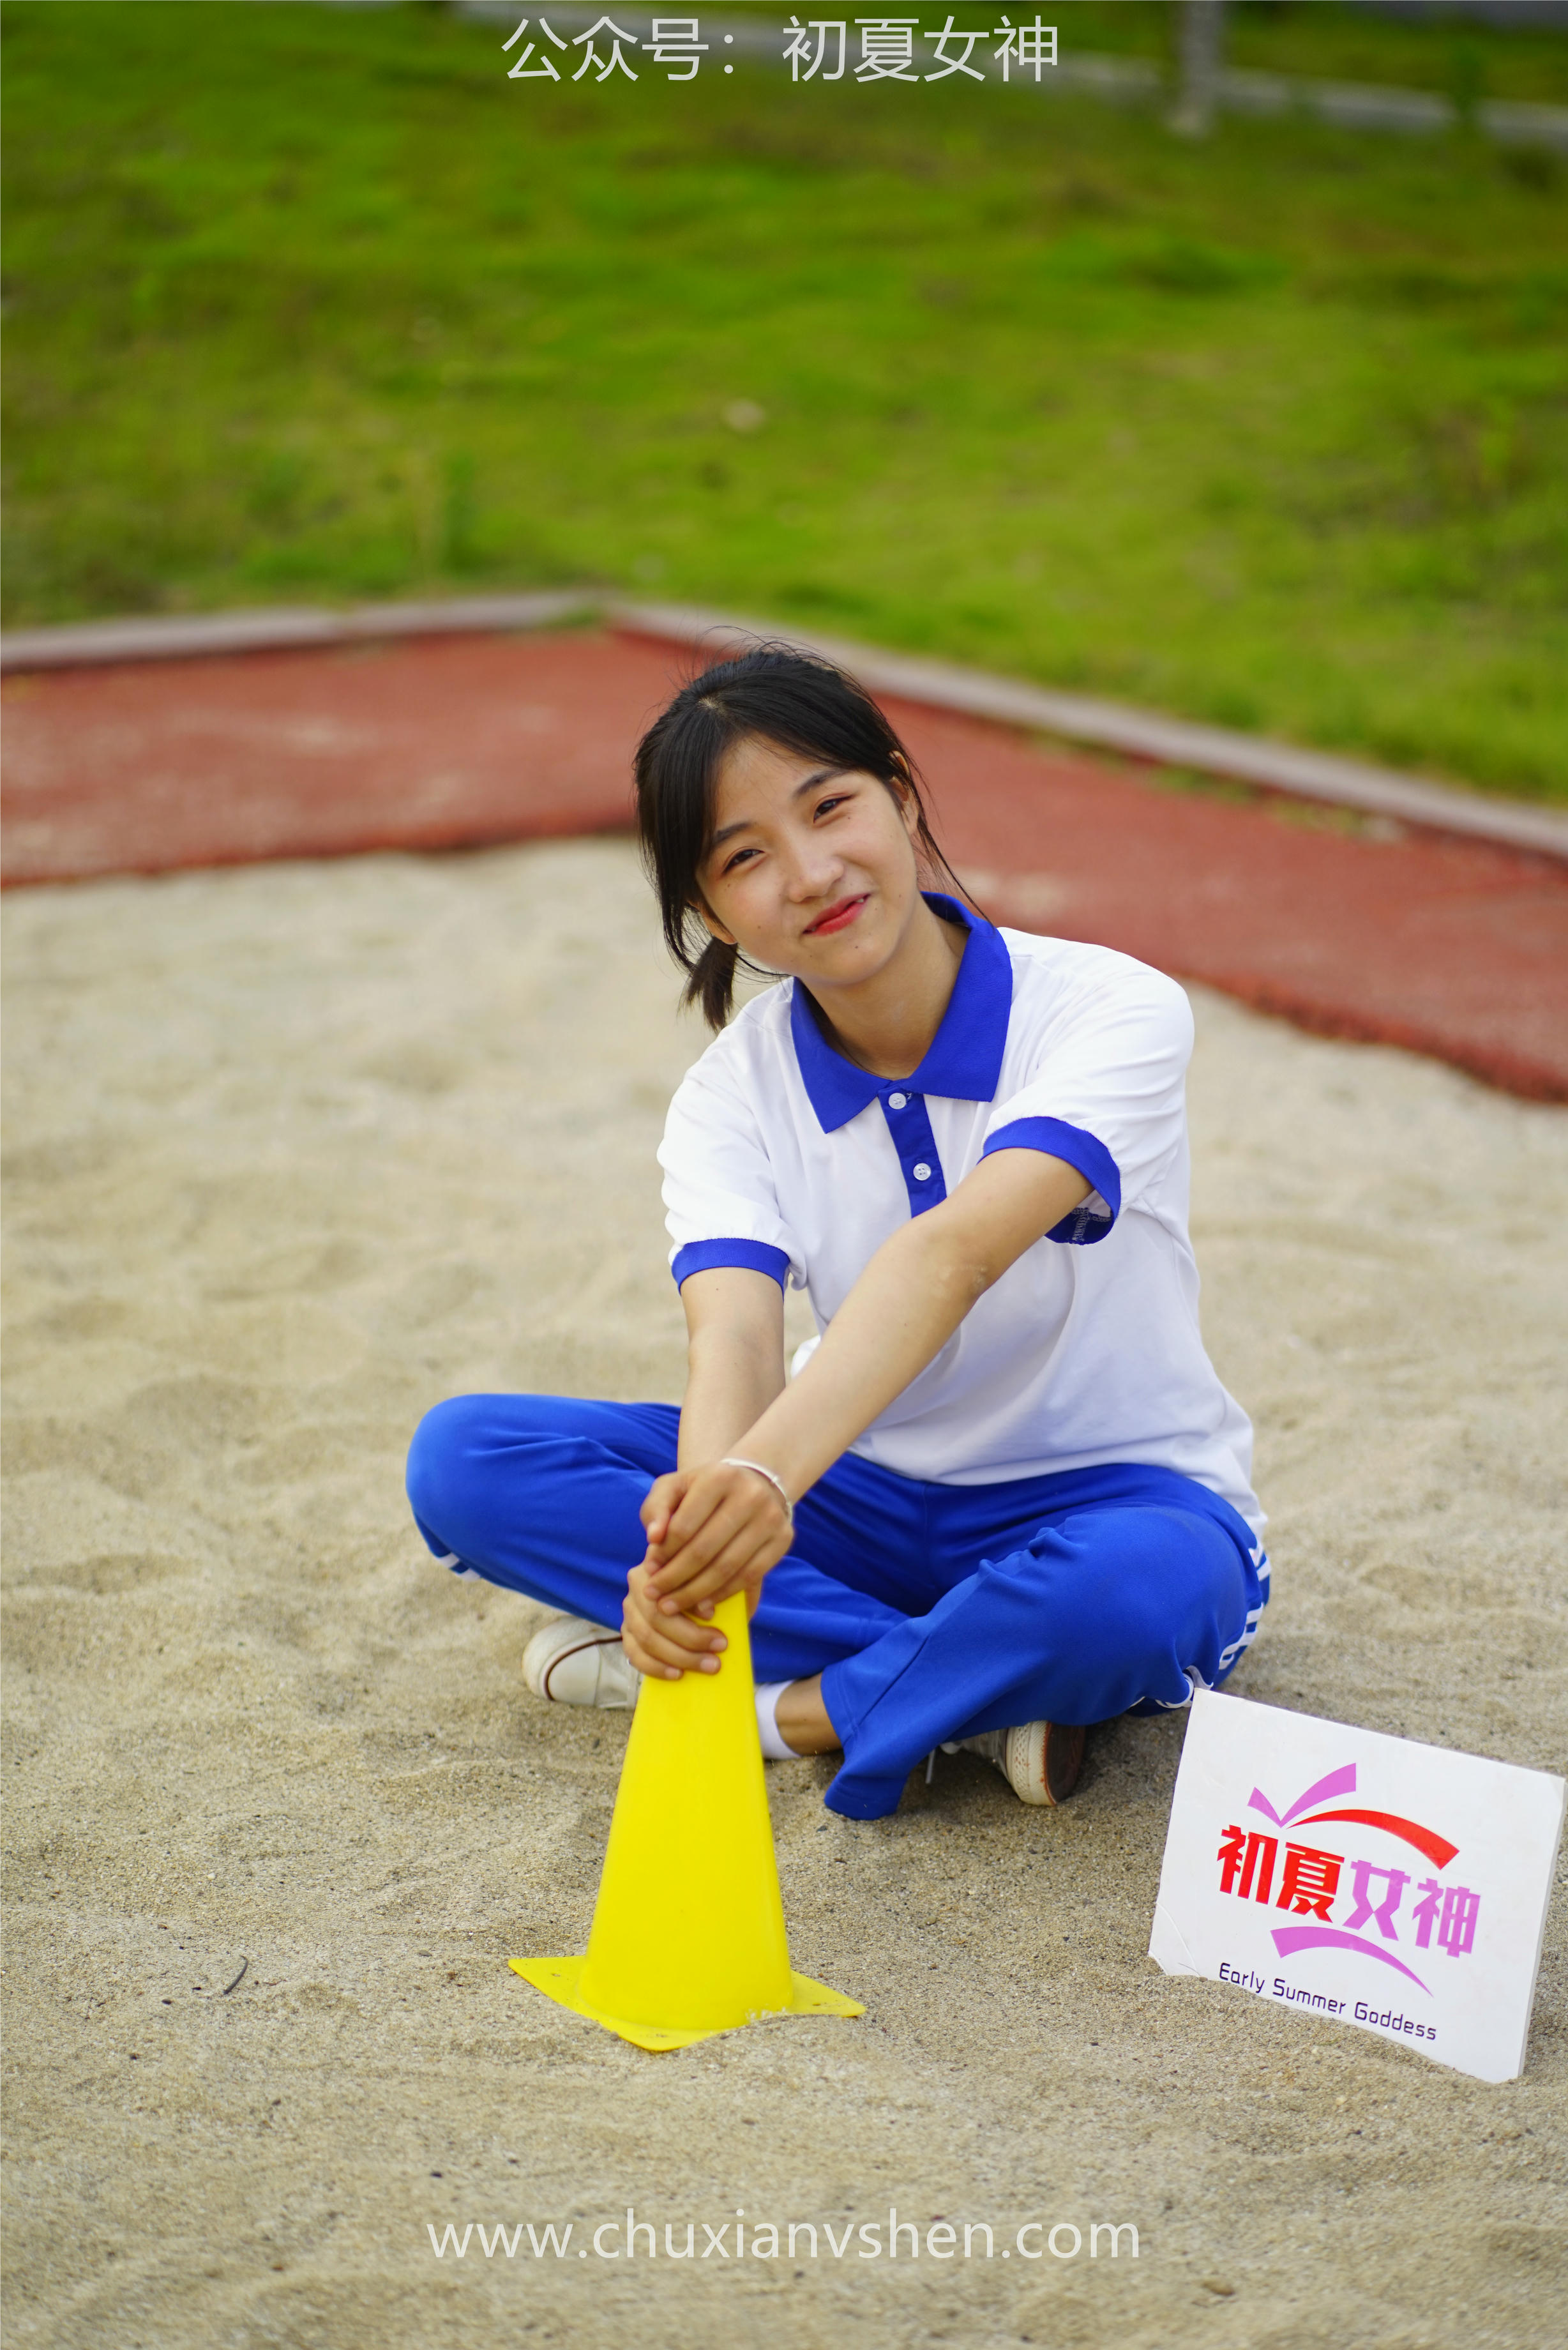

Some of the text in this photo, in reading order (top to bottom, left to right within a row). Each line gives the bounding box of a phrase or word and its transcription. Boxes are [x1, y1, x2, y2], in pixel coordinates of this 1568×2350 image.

[1217, 1824, 1481, 1958] 初夏女神
[1219, 1962, 1436, 2040] Early Summer Goddess
